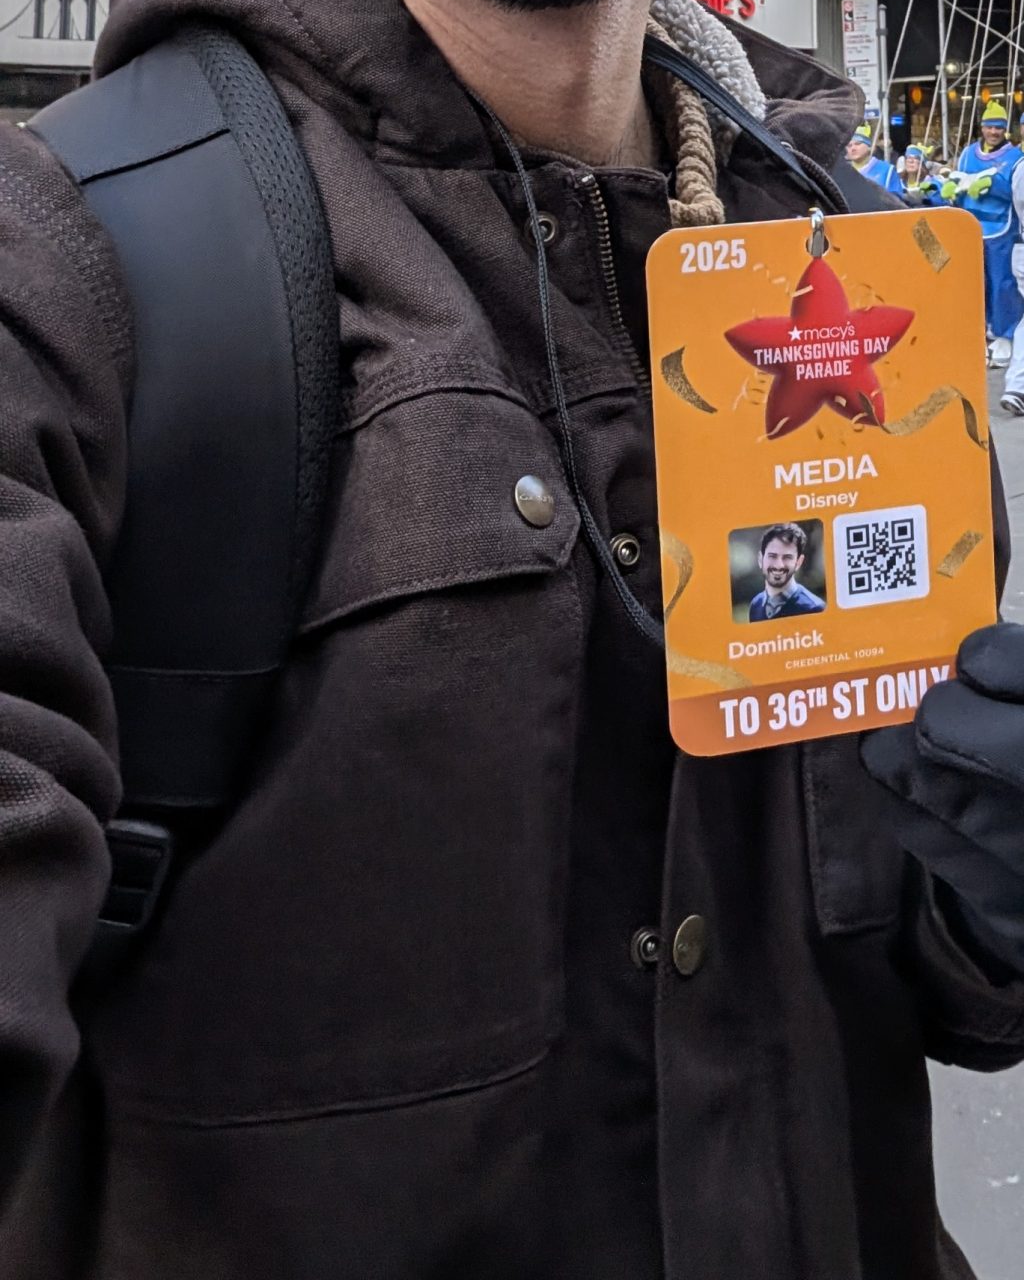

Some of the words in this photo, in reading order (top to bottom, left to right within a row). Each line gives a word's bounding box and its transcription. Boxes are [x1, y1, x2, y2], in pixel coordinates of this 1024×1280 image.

[680, 238, 748, 273] 2025
[803, 321, 856, 342] macy's
[754, 338, 860, 366] THANKSGIVING
[864, 336, 891, 355] DAY
[796, 359, 852, 381] PARADE
[774, 454, 878, 489] MEDIA
[796, 490, 859, 512] Disney
[729, 629, 825, 660] Dominick
[785, 652, 851, 670] CREDENTIAL
[719, 696, 760, 739] TO
[768, 686, 828, 731] 36TH
[832, 677, 869, 720] ST
